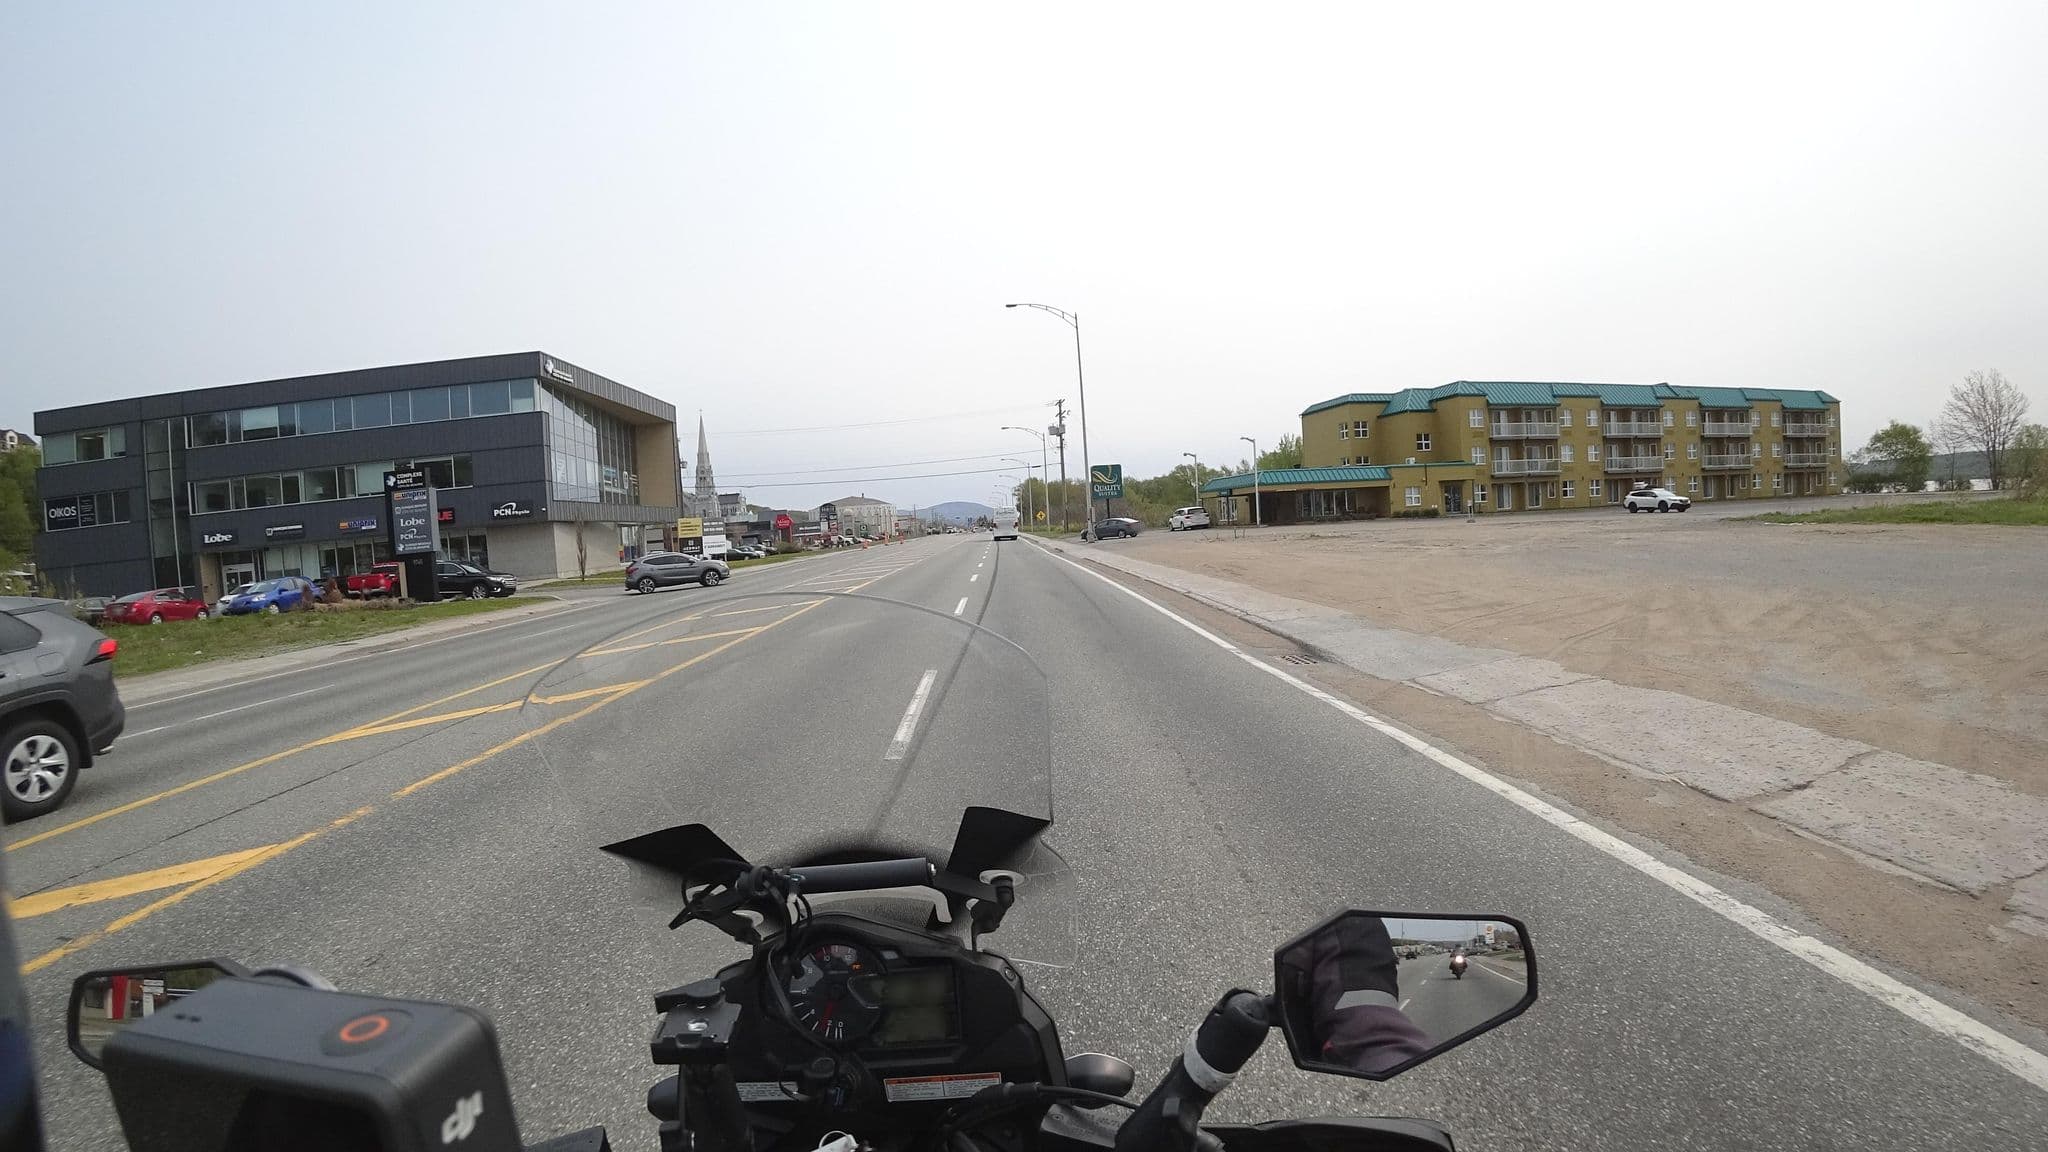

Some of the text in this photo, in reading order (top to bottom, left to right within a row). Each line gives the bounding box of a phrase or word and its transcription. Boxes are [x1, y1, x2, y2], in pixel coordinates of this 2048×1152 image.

[49, 506, 77, 518] OIKOS
[400, 518, 425, 526] Lobe
[203, 533, 232, 543] Lobe
[441, 1090, 483, 1144] dji
